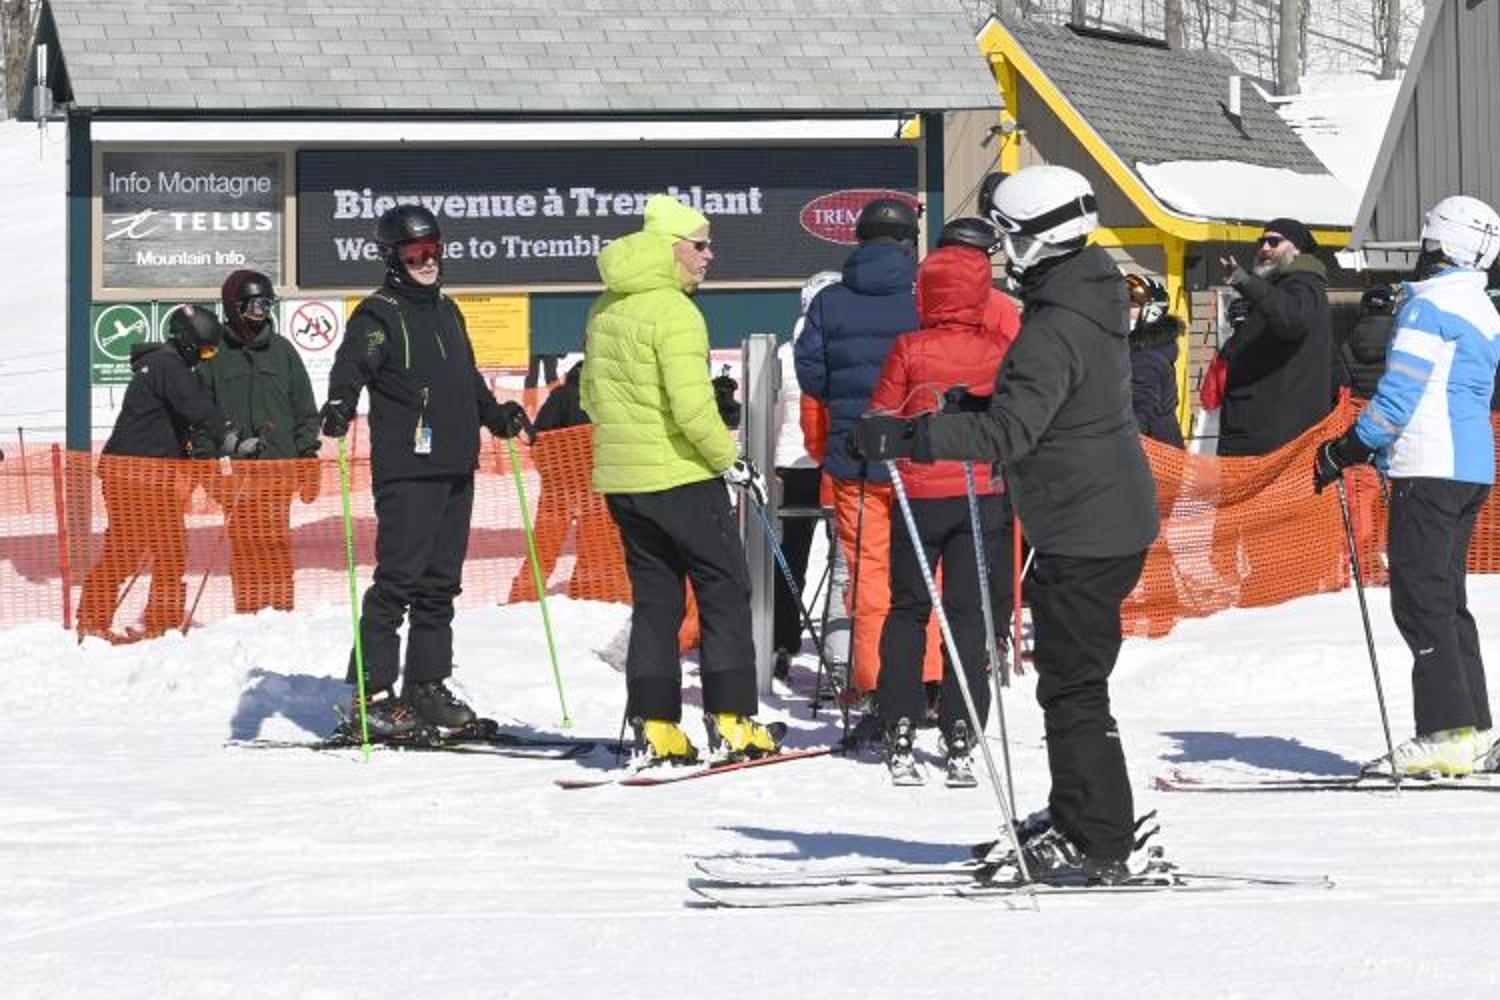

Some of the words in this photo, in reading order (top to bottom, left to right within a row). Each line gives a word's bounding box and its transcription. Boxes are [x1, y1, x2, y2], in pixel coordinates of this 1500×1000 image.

[109, 171, 150, 193] Info
[158, 171, 272, 198] Montagne
[542, 187, 564, 217] à
[170, 211, 273, 232] TELUS
[136, 251, 211, 266] Mountain
[215, 251, 246, 266] Info
[469, 237, 497, 259] to
